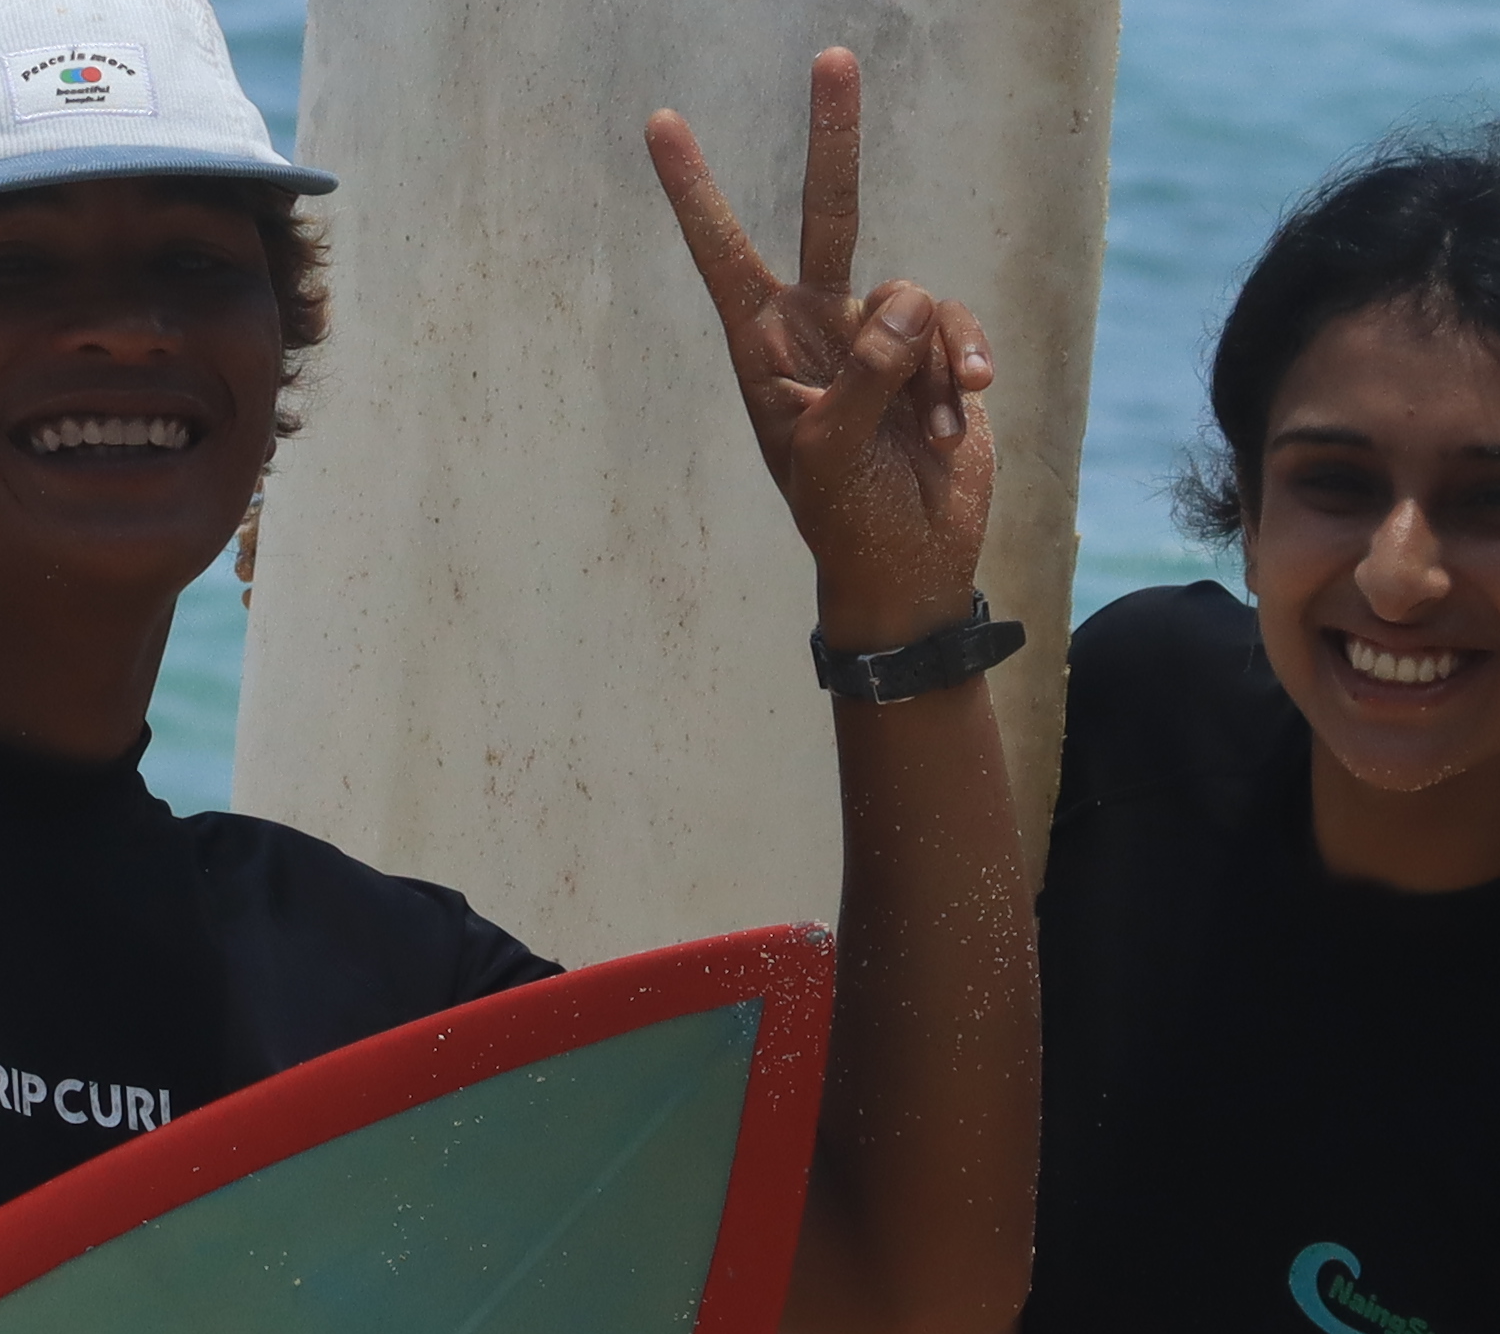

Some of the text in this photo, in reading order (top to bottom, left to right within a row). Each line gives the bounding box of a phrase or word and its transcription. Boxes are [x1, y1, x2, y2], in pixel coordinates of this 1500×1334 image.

[20, 50, 136, 82] Peace is more
